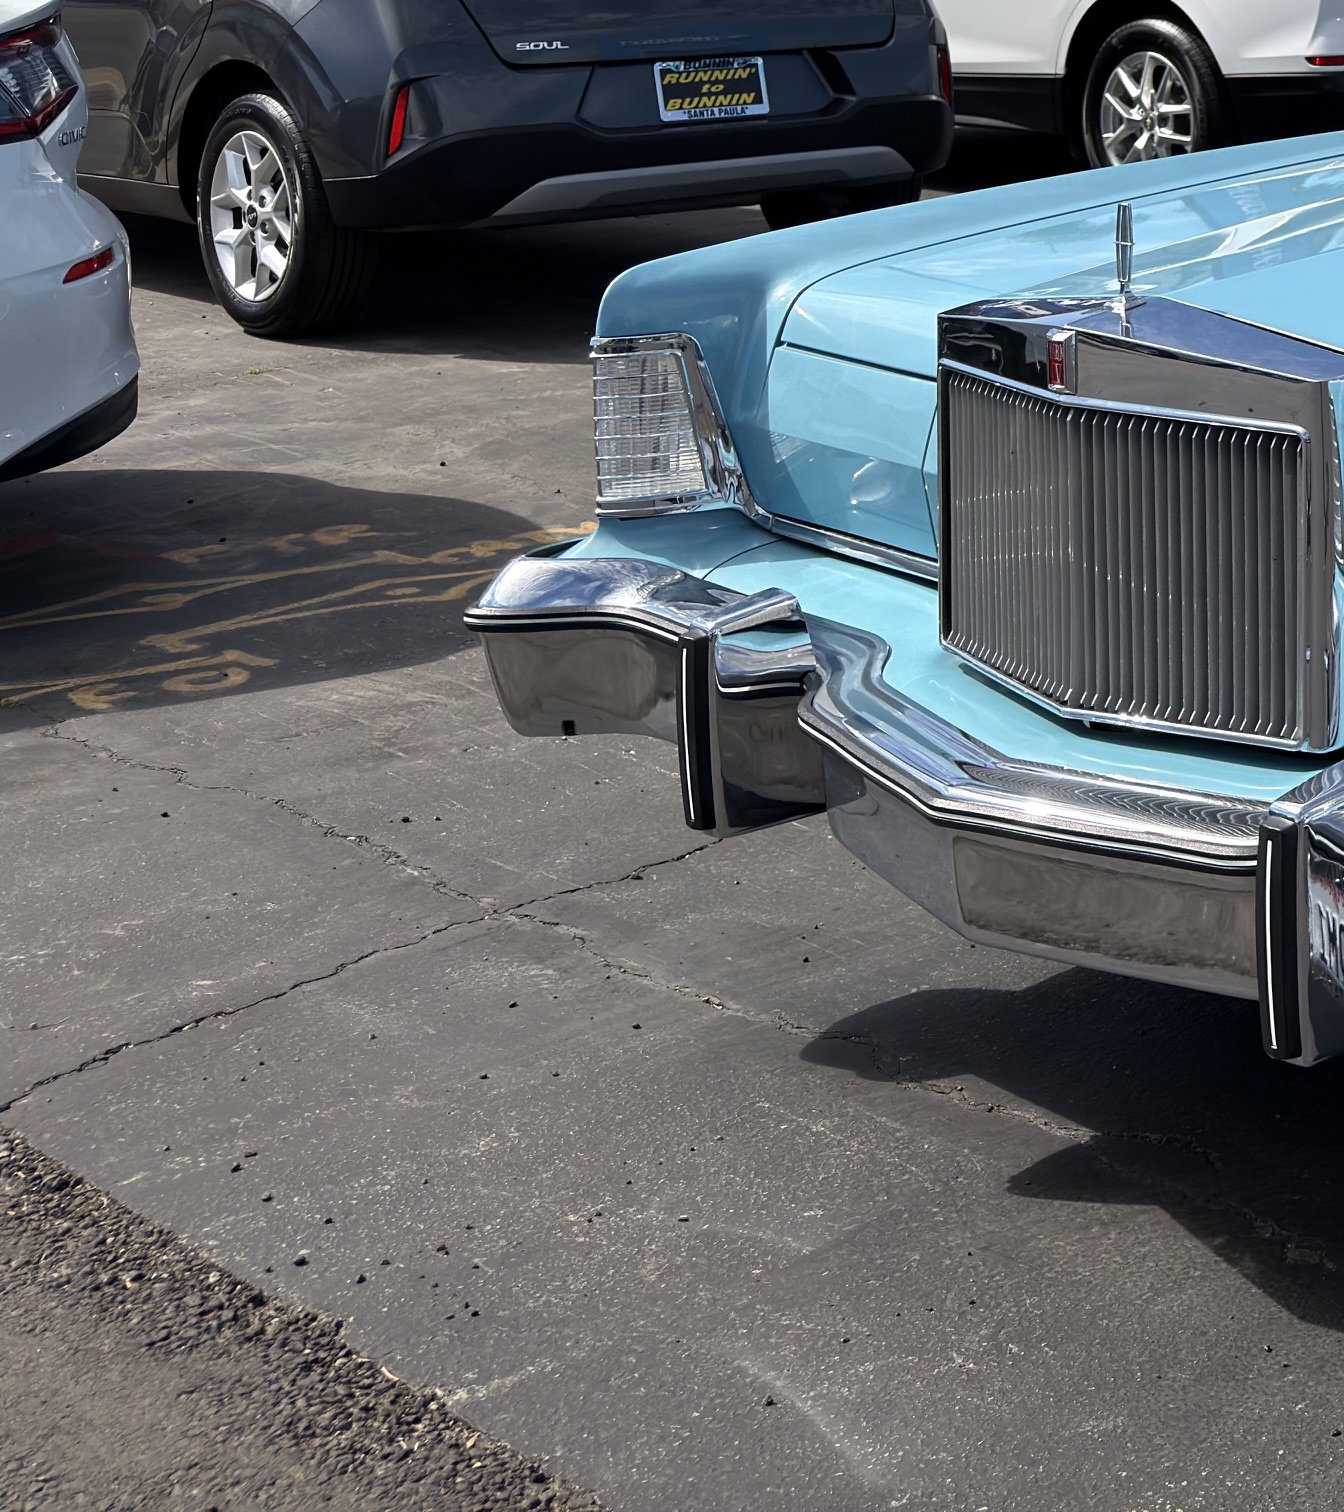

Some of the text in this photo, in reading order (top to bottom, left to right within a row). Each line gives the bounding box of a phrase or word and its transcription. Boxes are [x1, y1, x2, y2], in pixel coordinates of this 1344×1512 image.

[516, 41, 570, 51] SOUL
[662, 67, 757, 85] RUNNIN'
[701, 83, 725, 93] to
[665, 92, 756, 111] BUNNIN
